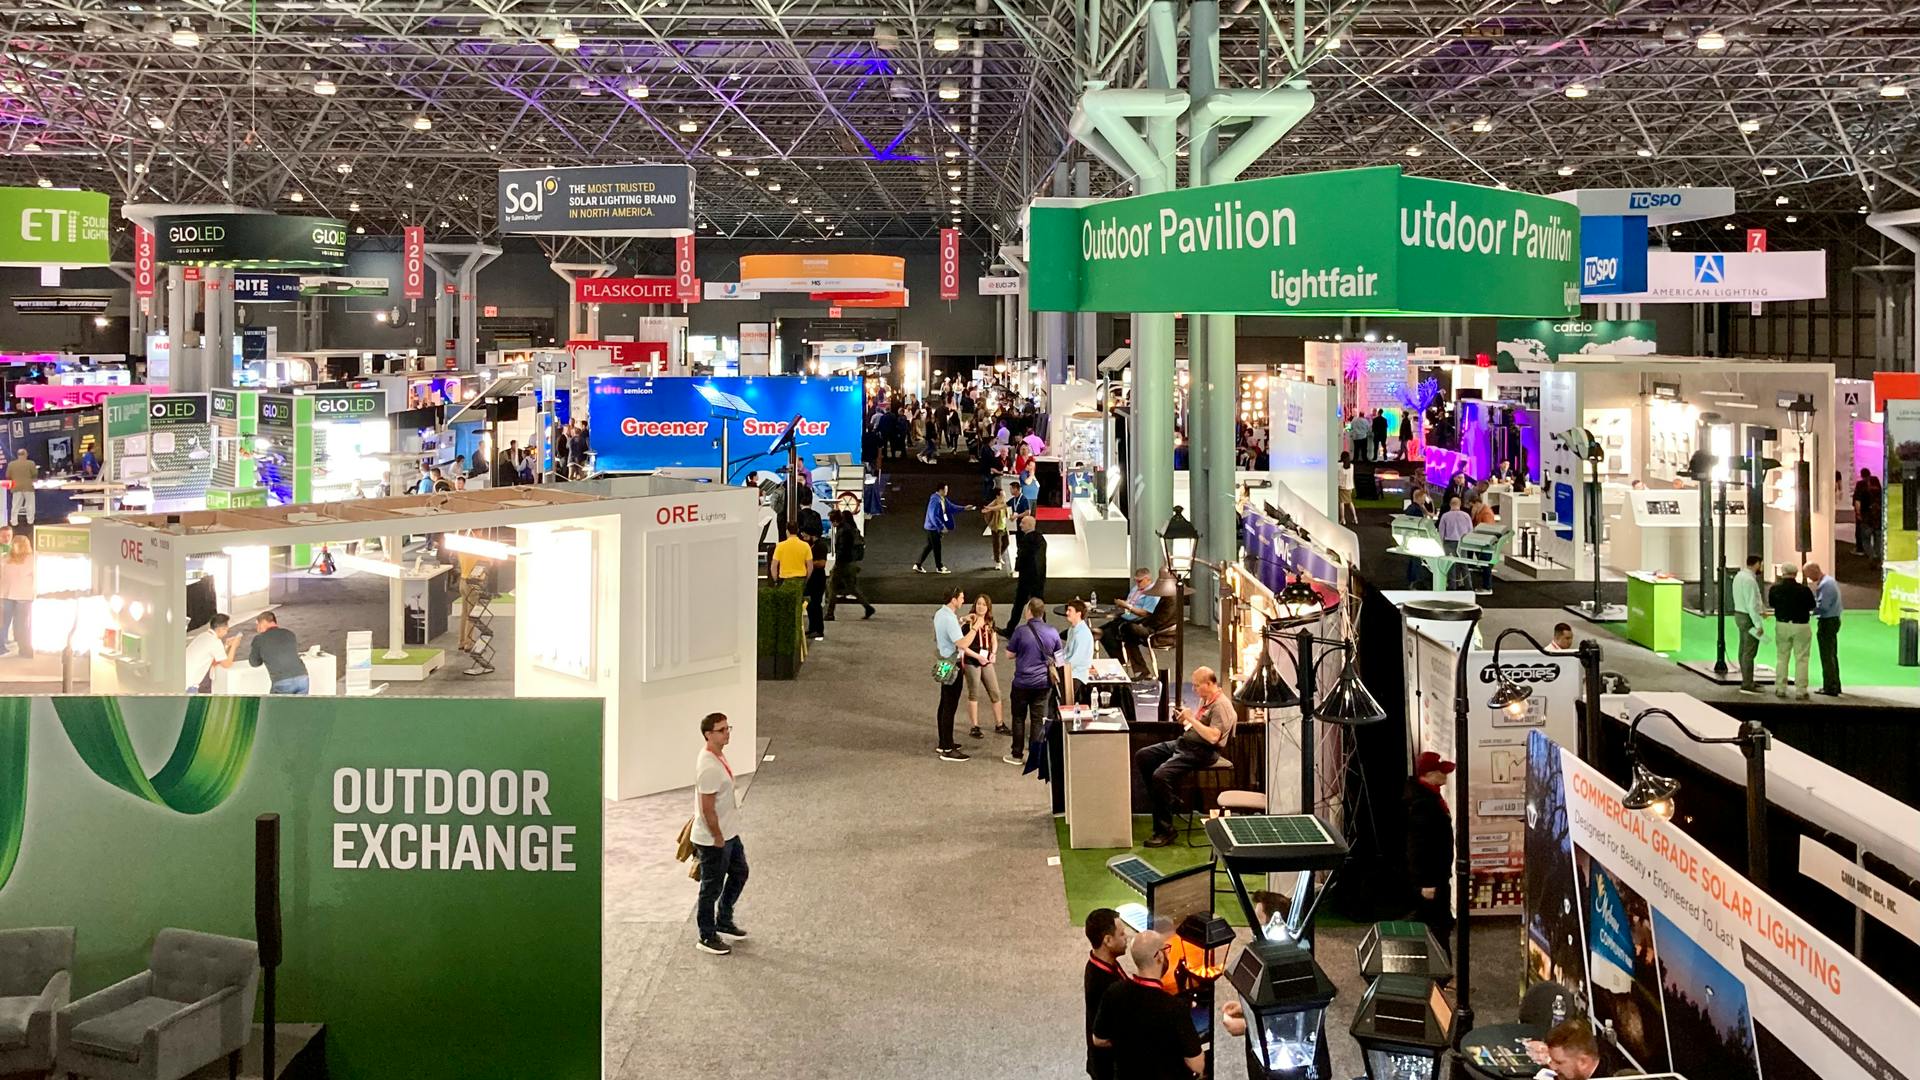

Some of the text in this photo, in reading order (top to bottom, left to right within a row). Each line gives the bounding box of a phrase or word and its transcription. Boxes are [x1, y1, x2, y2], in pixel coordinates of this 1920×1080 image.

[569, 182, 656, 194] THE MOST TRUSTED
[569, 194, 677, 207] SOLAR LIGHTING BRAND
[1629, 192, 1682, 209] TOSPO
[569, 207, 656, 219] IN NORTH AMERICA.
[169, 226, 225, 242] GLOLED
[312, 229, 347, 246] GLOLED
[1082, 200, 1297, 261] Outdoor Pavilion
[1512, 209, 1572, 262] Pavilion
[409, 230, 420, 286] 1200
[944, 232, 955, 288] 1000
[583, 285, 673, 297] PLASKOLITE
[1652, 288, 1769, 297] AMERICAN LIGHTING
[1553, 321, 1593, 333] carclo
[150, 403, 196, 417] OLED
[621, 417, 830, 437] Greener Smater
[656, 504, 699, 525] ORE
[120, 539, 144, 563] ORE
[333, 768, 552, 816] OUTDOOR
[333, 823, 577, 872] EXCHANGE
[1572, 773, 1841, 995] COMMERCIAL GRADE SOLAR LIGHTING
[1574, 810, 1734, 948] Designed For Beauty Engineered To Last
